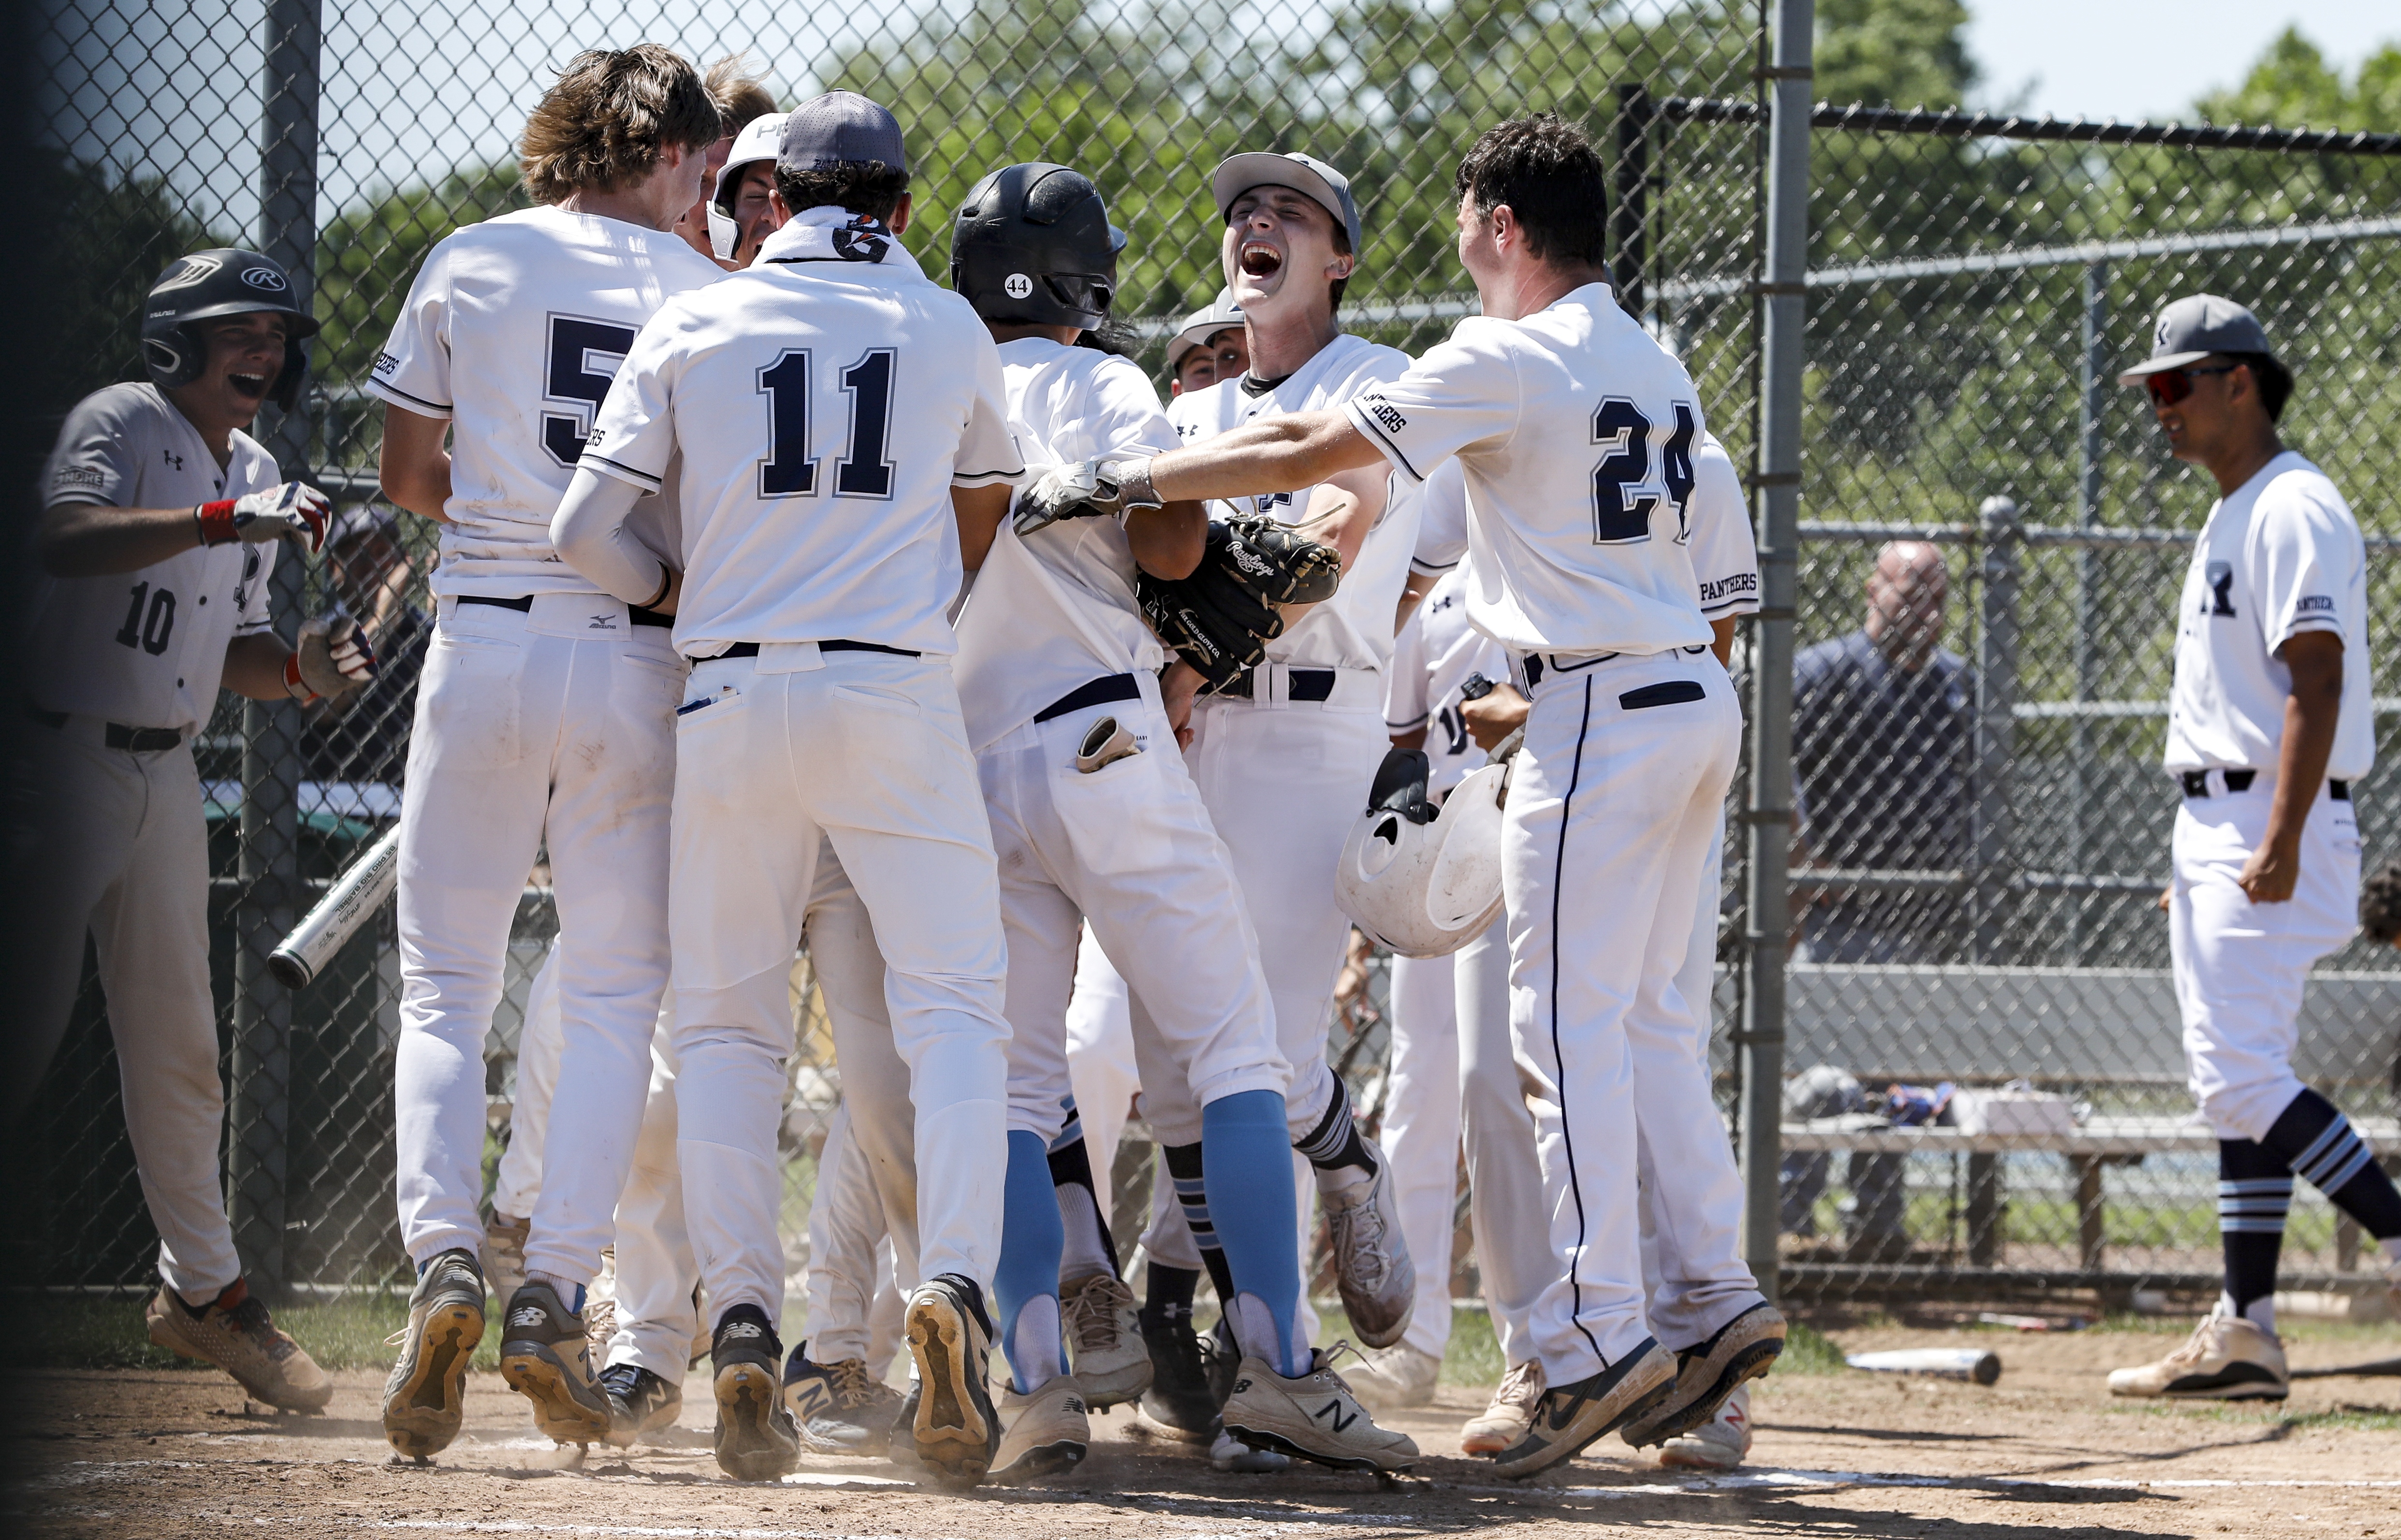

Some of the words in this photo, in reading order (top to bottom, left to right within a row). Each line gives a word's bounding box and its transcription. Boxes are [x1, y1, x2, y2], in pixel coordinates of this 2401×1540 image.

[1007, 278, 1028, 292] 44
[539, 311, 643, 469] 5
[756, 347, 898, 501] 11
[1363, 392, 1407, 434] NTHERS
[1590, 395, 1696, 546] 24
[1225, 541, 1274, 576] Rawlings
[1700, 573, 1757, 601] PANTHERS
[116, 581, 177, 657] 10
[1186, 620, 1199, 634] GOLD
[1197, 633, 1214, 650] GLOVE
[360, 872, 373, 886] BIG
[372, 856, 386, 872] PRO
[335, 886, 361, 913] BARREL
[1314, 1398, 1358, 1434] N
